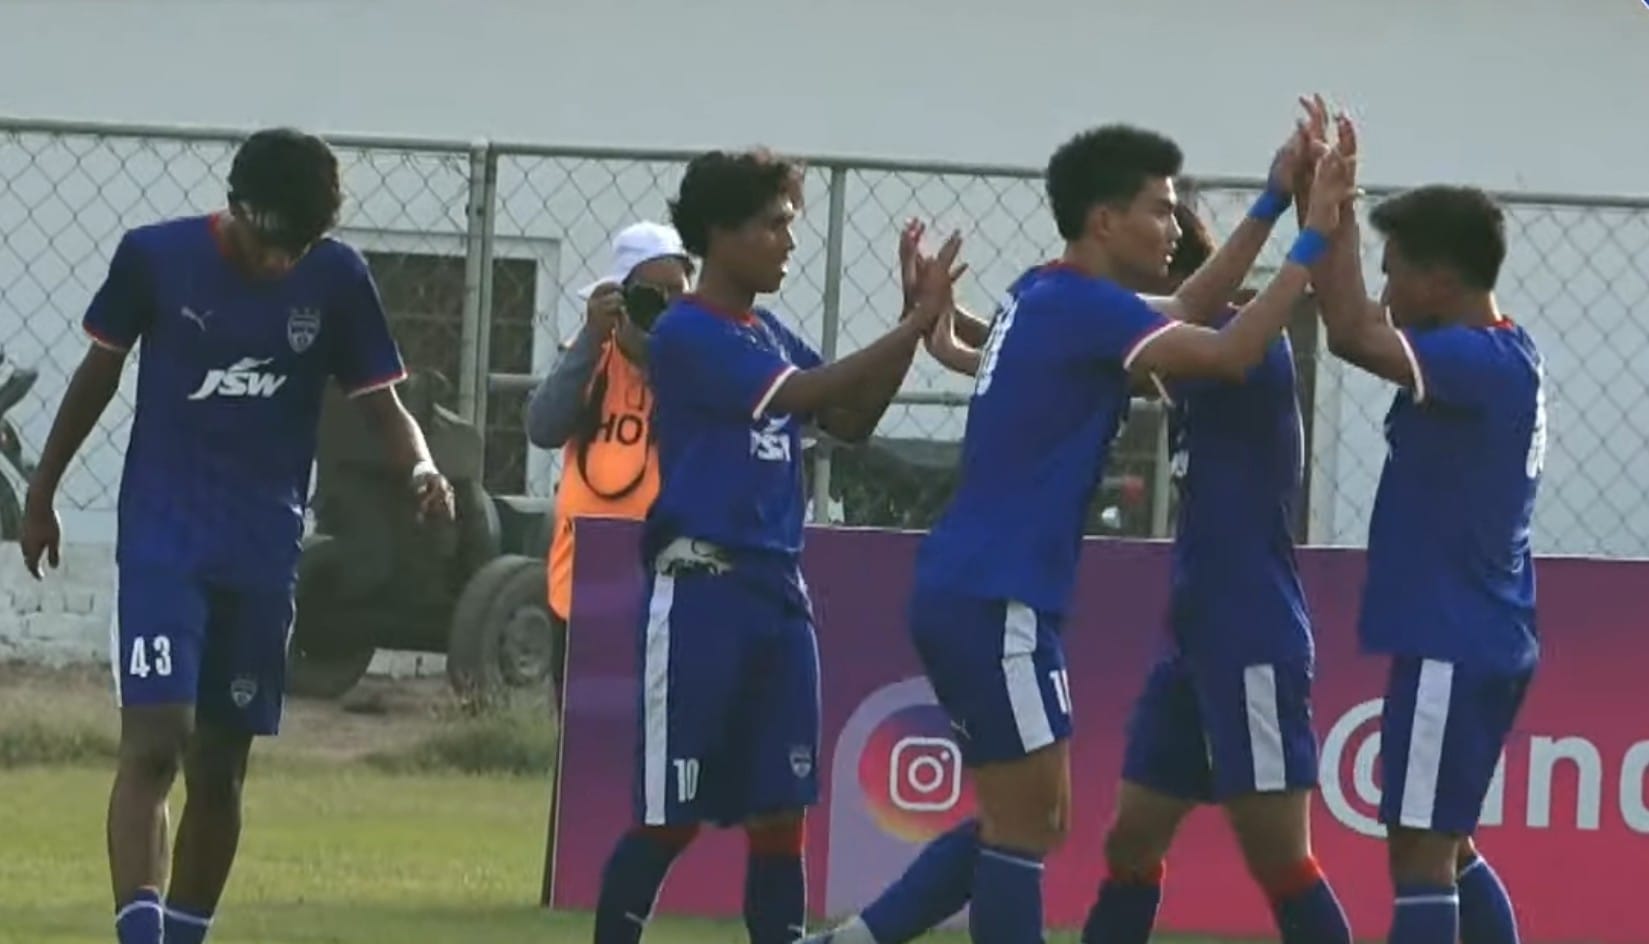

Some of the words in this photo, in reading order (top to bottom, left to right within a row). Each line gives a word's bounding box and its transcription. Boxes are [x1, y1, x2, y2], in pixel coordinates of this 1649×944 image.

[187, 369, 287, 400] JSW
[129, 635, 172, 678] 43
[673, 758, 700, 802] 10
